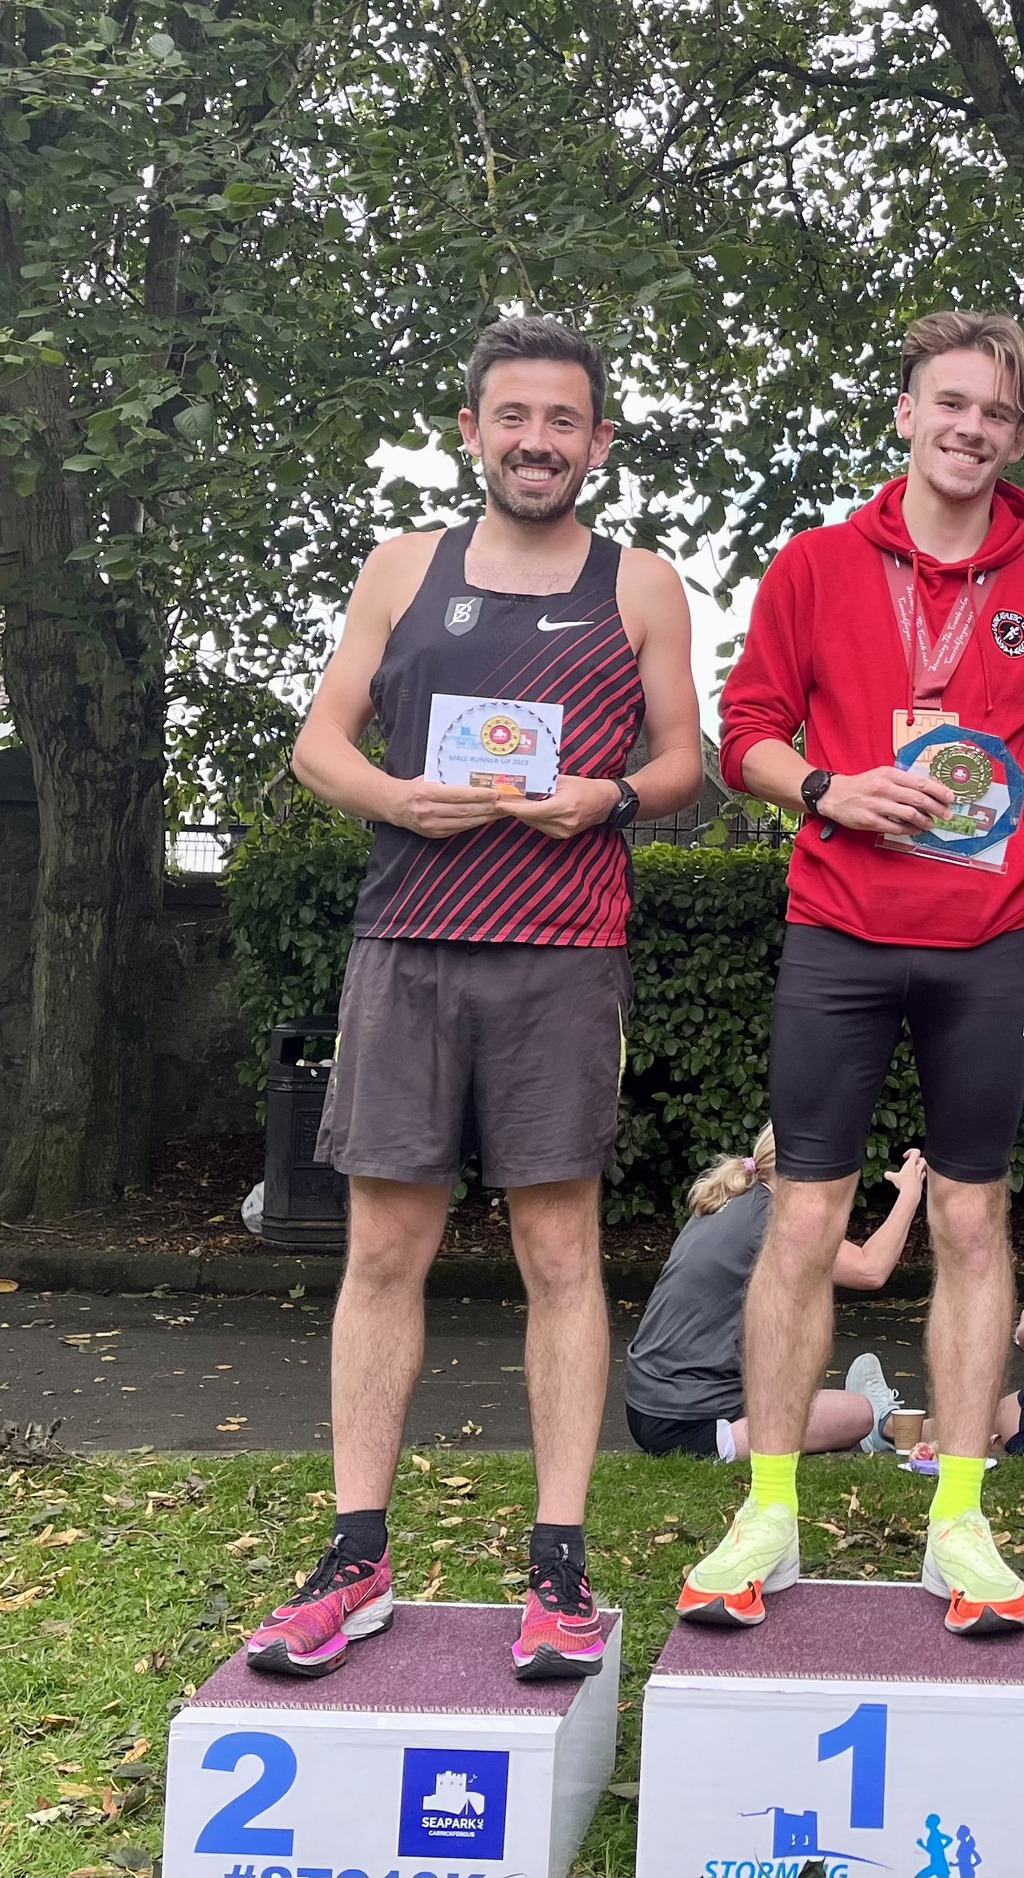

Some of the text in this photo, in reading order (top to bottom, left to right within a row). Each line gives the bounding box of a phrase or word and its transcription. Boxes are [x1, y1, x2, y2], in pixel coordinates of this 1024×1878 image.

[927, 644, 949, 672] Storming
[941, 631, 953, 644] The
[947, 610, 962, 630] Castle
[944, 623, 969, 664] Carrickfergus
[469, 756, 511, 764] RUNNER-UP
[512, 758, 529, 766] 2023
[818, 1703, 888, 1829] 1
[194, 1731, 298, 1857] 2
[421, 1817, 476, 1829] SEAPARK
[477, 1818, 484, 1830] AC
[705, 1860, 849, 1878] STORMG
